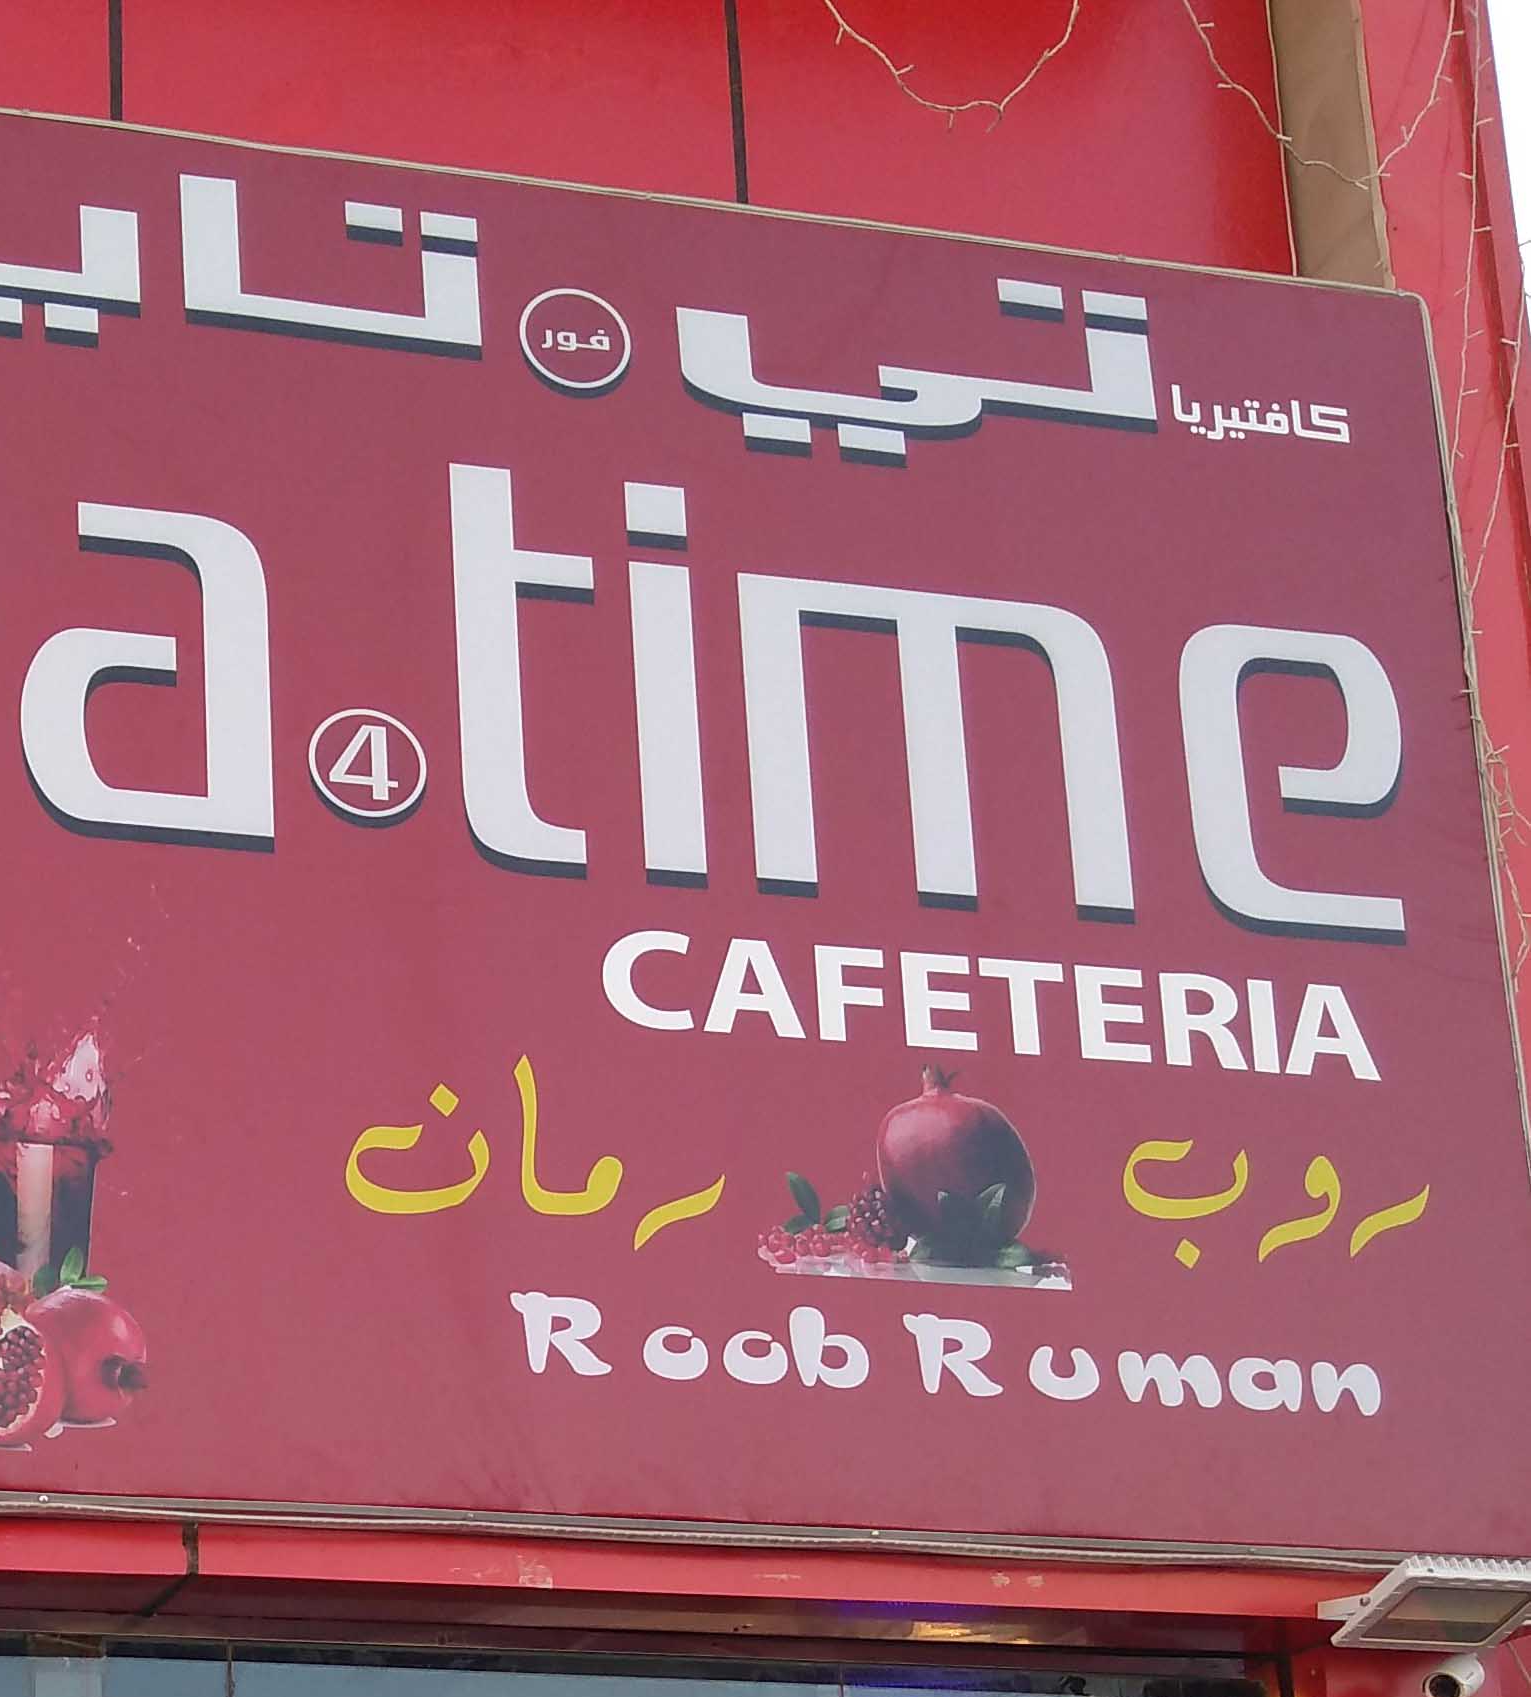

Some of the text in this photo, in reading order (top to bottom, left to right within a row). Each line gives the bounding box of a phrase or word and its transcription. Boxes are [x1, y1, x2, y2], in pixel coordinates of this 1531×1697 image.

[541, 329, 610, 352] فور
[676, 277, 1158, 460] تي
[1170, 383, 1351, 444] كافتيريا
[448, 462, 1406, 938] time
[601, 929, 1383, 1083] CAFETERIA
[345, 1054, 1431, 1270] روب رمان
